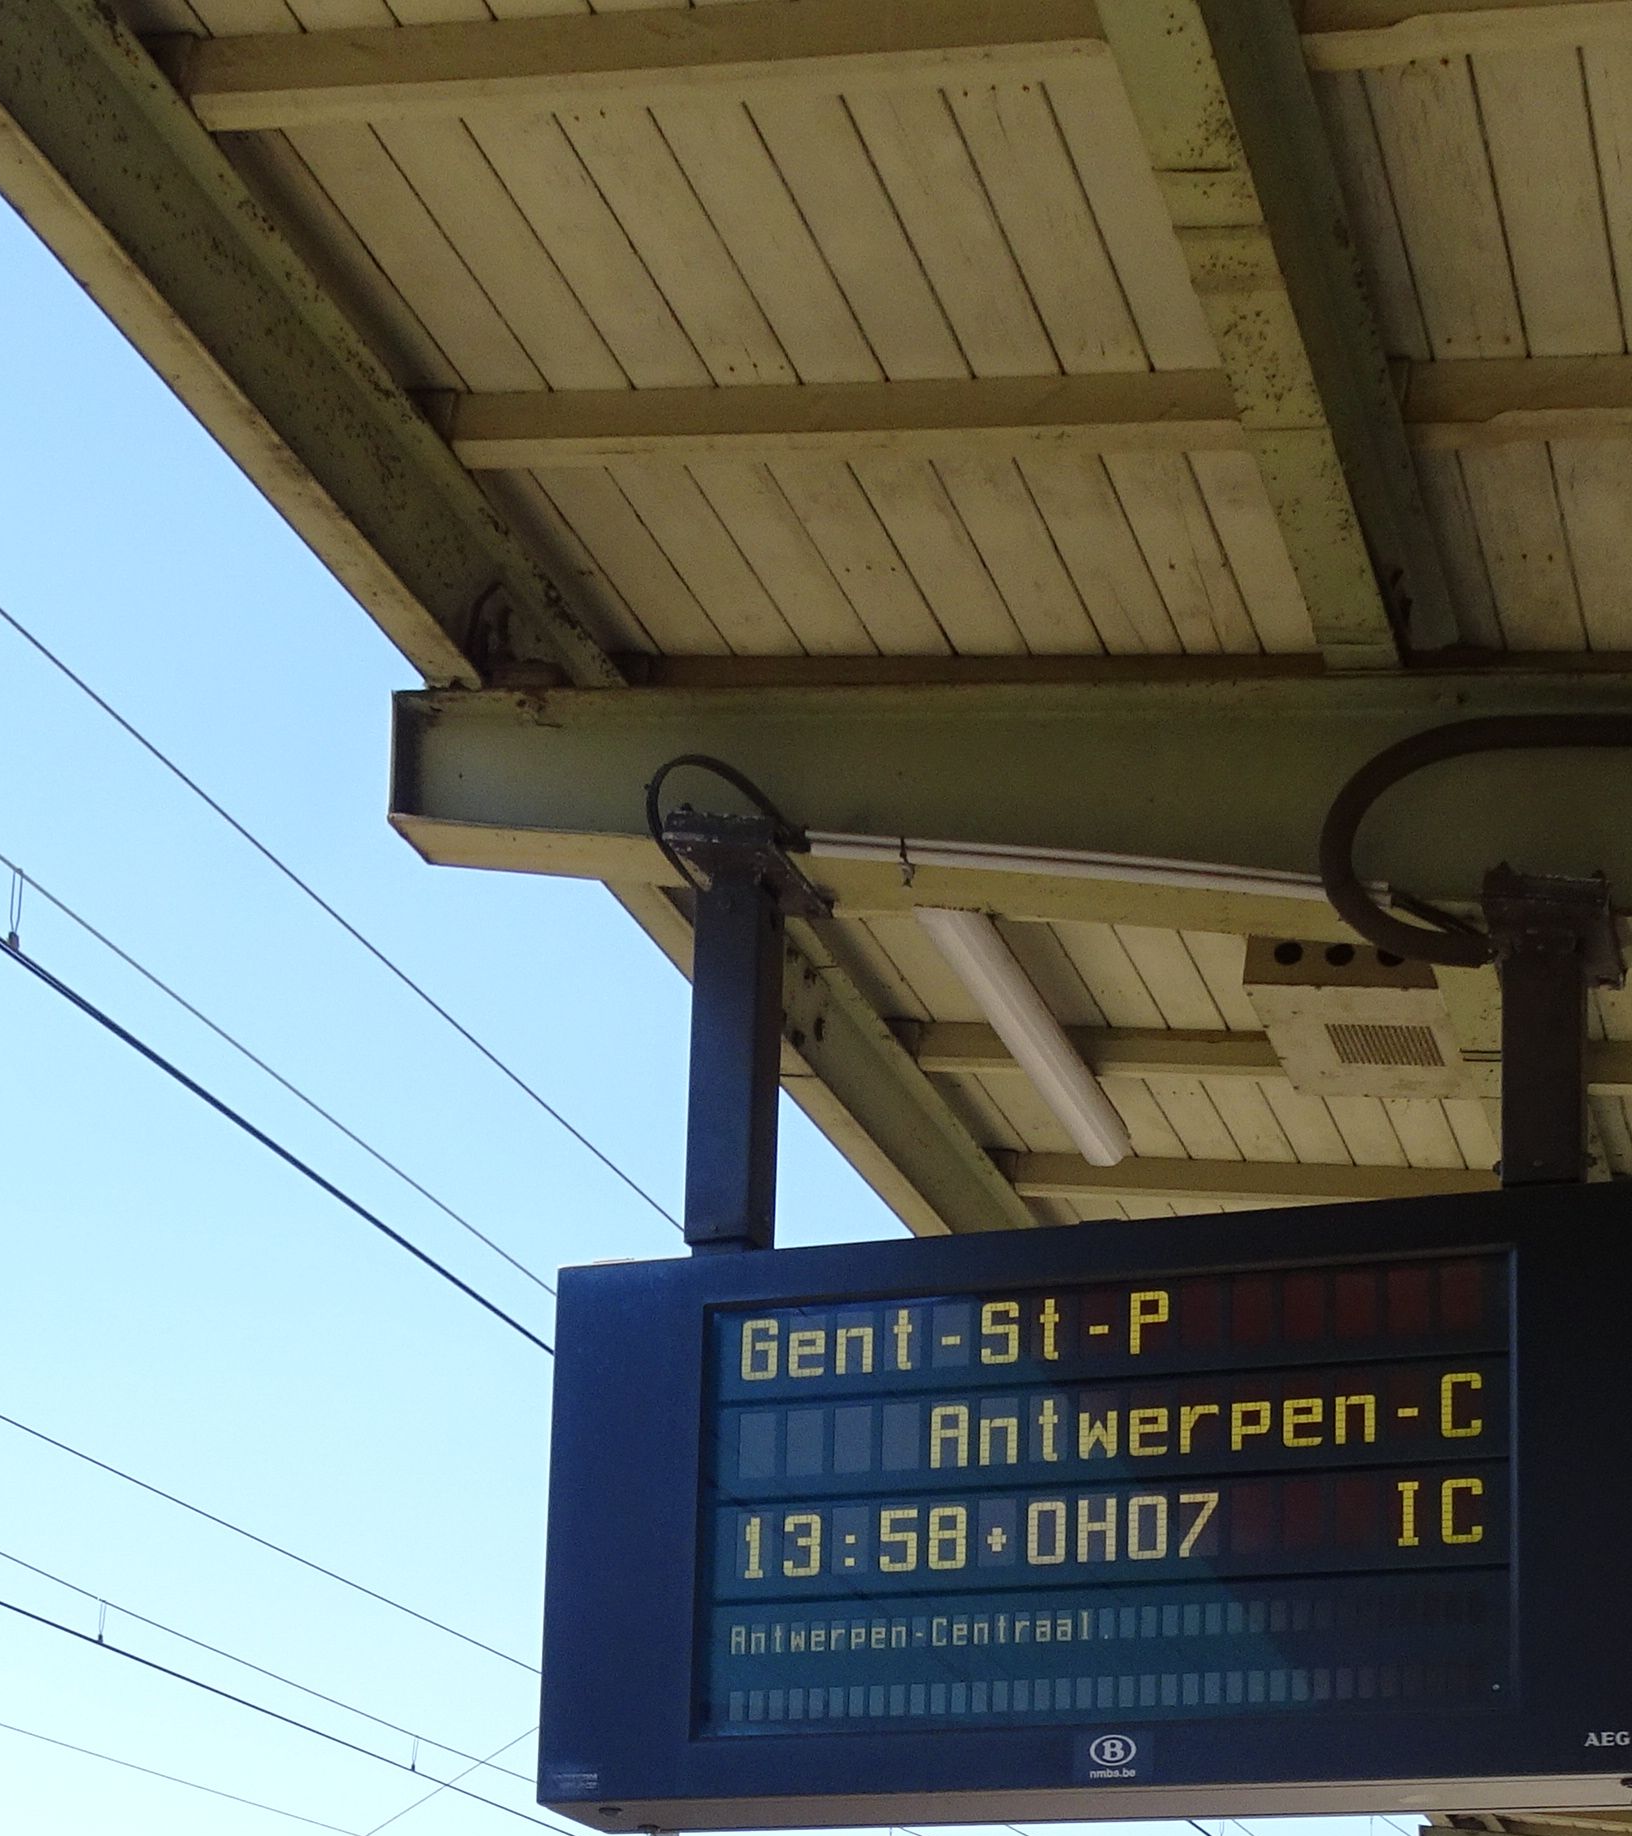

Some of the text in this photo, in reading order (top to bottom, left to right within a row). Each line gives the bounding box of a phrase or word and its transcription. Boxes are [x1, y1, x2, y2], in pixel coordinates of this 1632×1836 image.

[741, 1291, 1170, 1382] Gent-St-P
[930, 1372, 1485, 1469] Antwerpen-C
[1397, 1477, 1485, 1548] IC
[1089, 1767, 1137, 1779] nmbs.be
[1584, 1730, 1631, 1747] AEG
